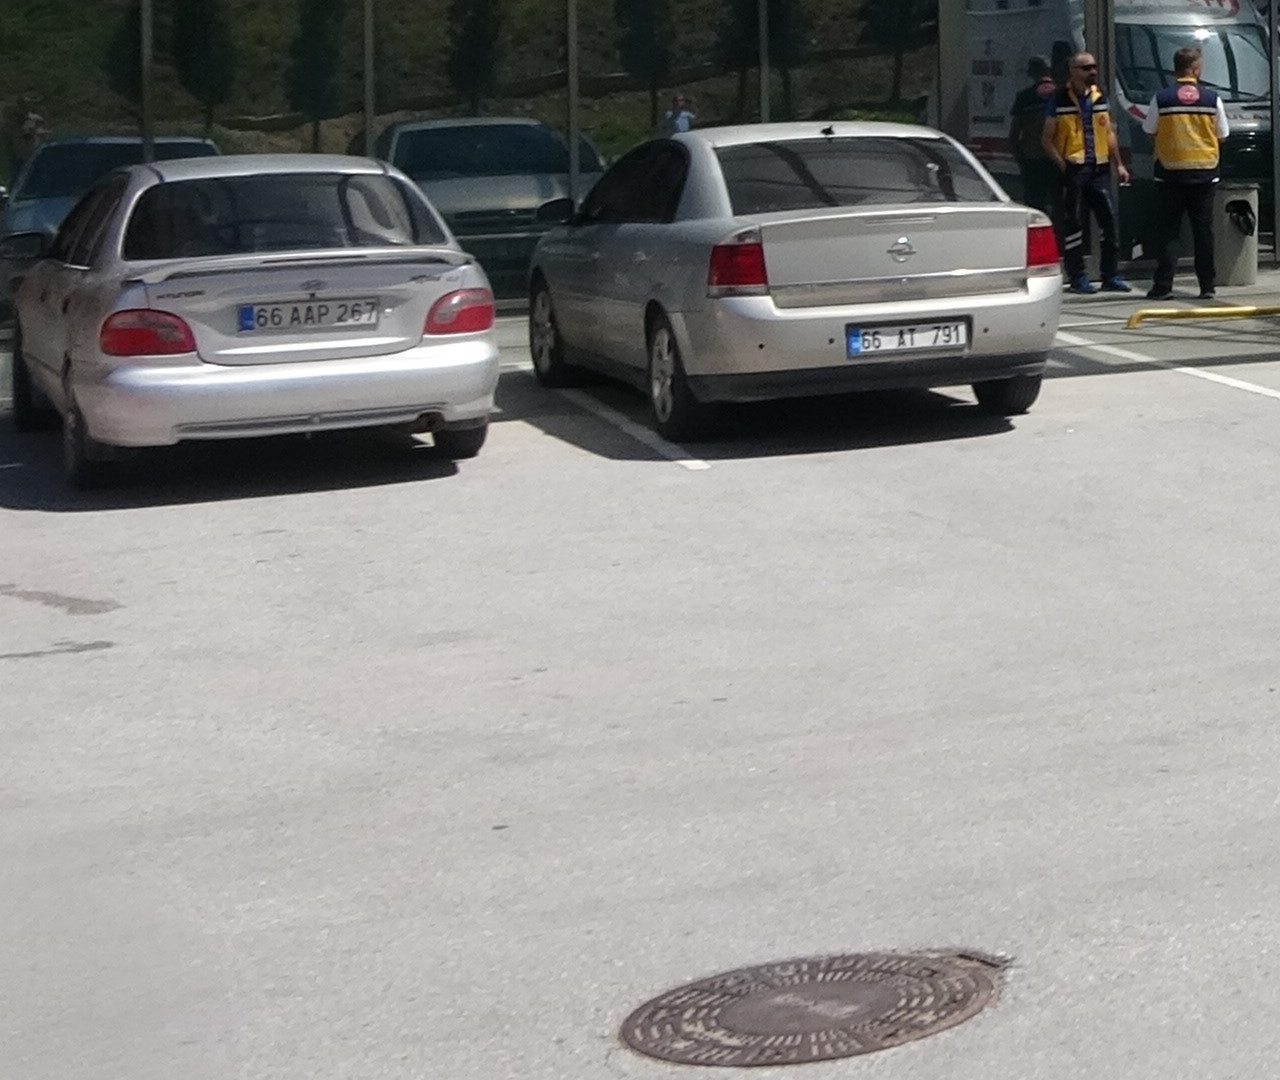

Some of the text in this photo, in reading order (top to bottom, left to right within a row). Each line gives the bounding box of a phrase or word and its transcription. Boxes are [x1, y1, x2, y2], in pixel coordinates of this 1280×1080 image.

[256, 301, 376, 328] 66 AAP 267
[861, 324, 960, 350] 66 AT 791
